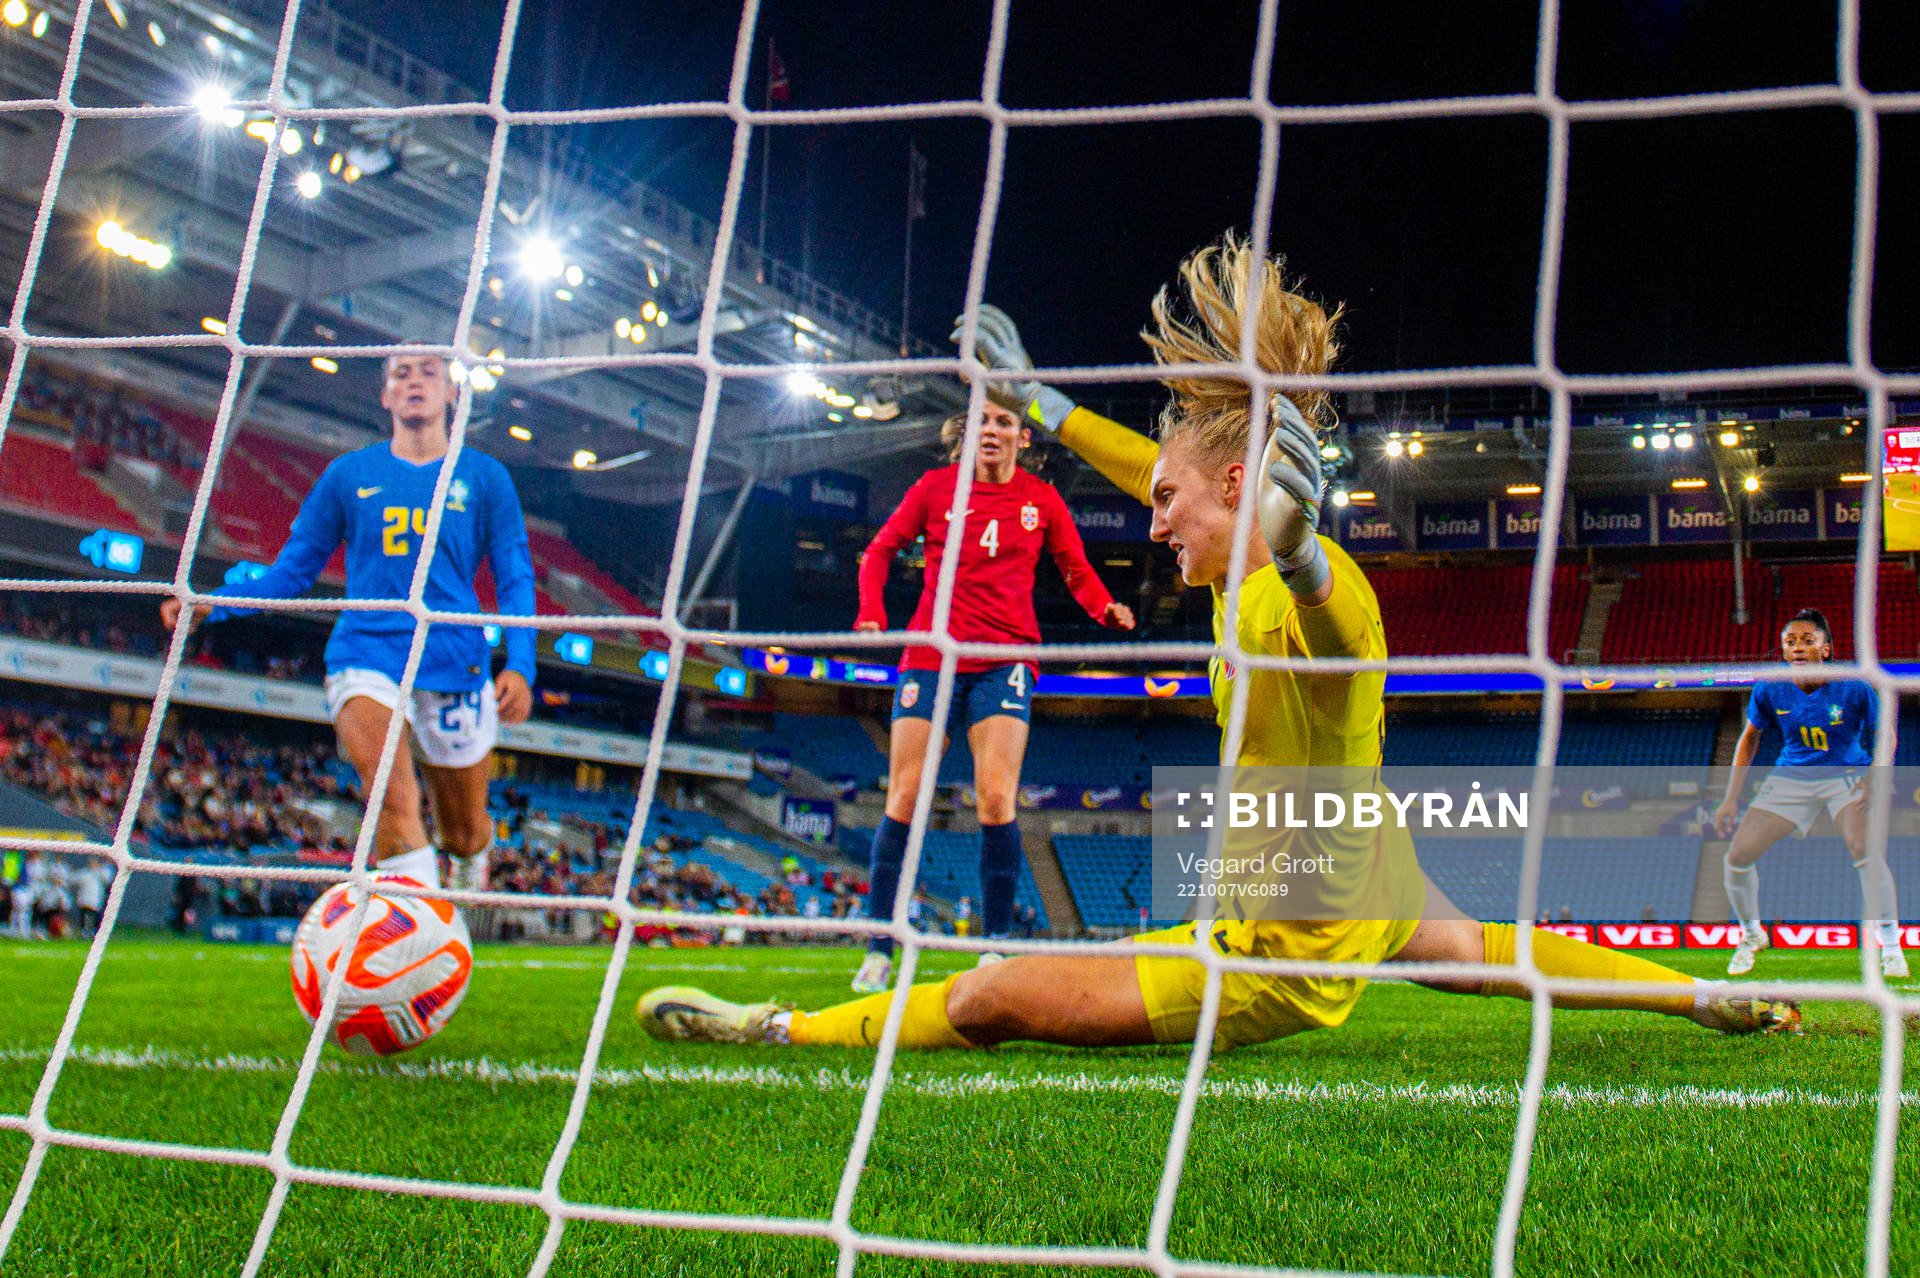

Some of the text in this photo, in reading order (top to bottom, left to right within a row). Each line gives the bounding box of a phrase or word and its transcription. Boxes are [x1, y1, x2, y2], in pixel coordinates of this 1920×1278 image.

[1583, 510, 1642, 531] bama
[1668, 507, 1727, 529] bama
[1748, 504, 1810, 525] bama
[1350, 519, 1397, 540] bam
[1422, 514, 1480, 537] bama
[979, 518, 999, 558] 4
[1007, 662, 1026, 698] 4
[1800, 726, 1829, 752] 10
[1602, 926, 1675, 946] VG
[1777, 926, 1851, 946] VG
